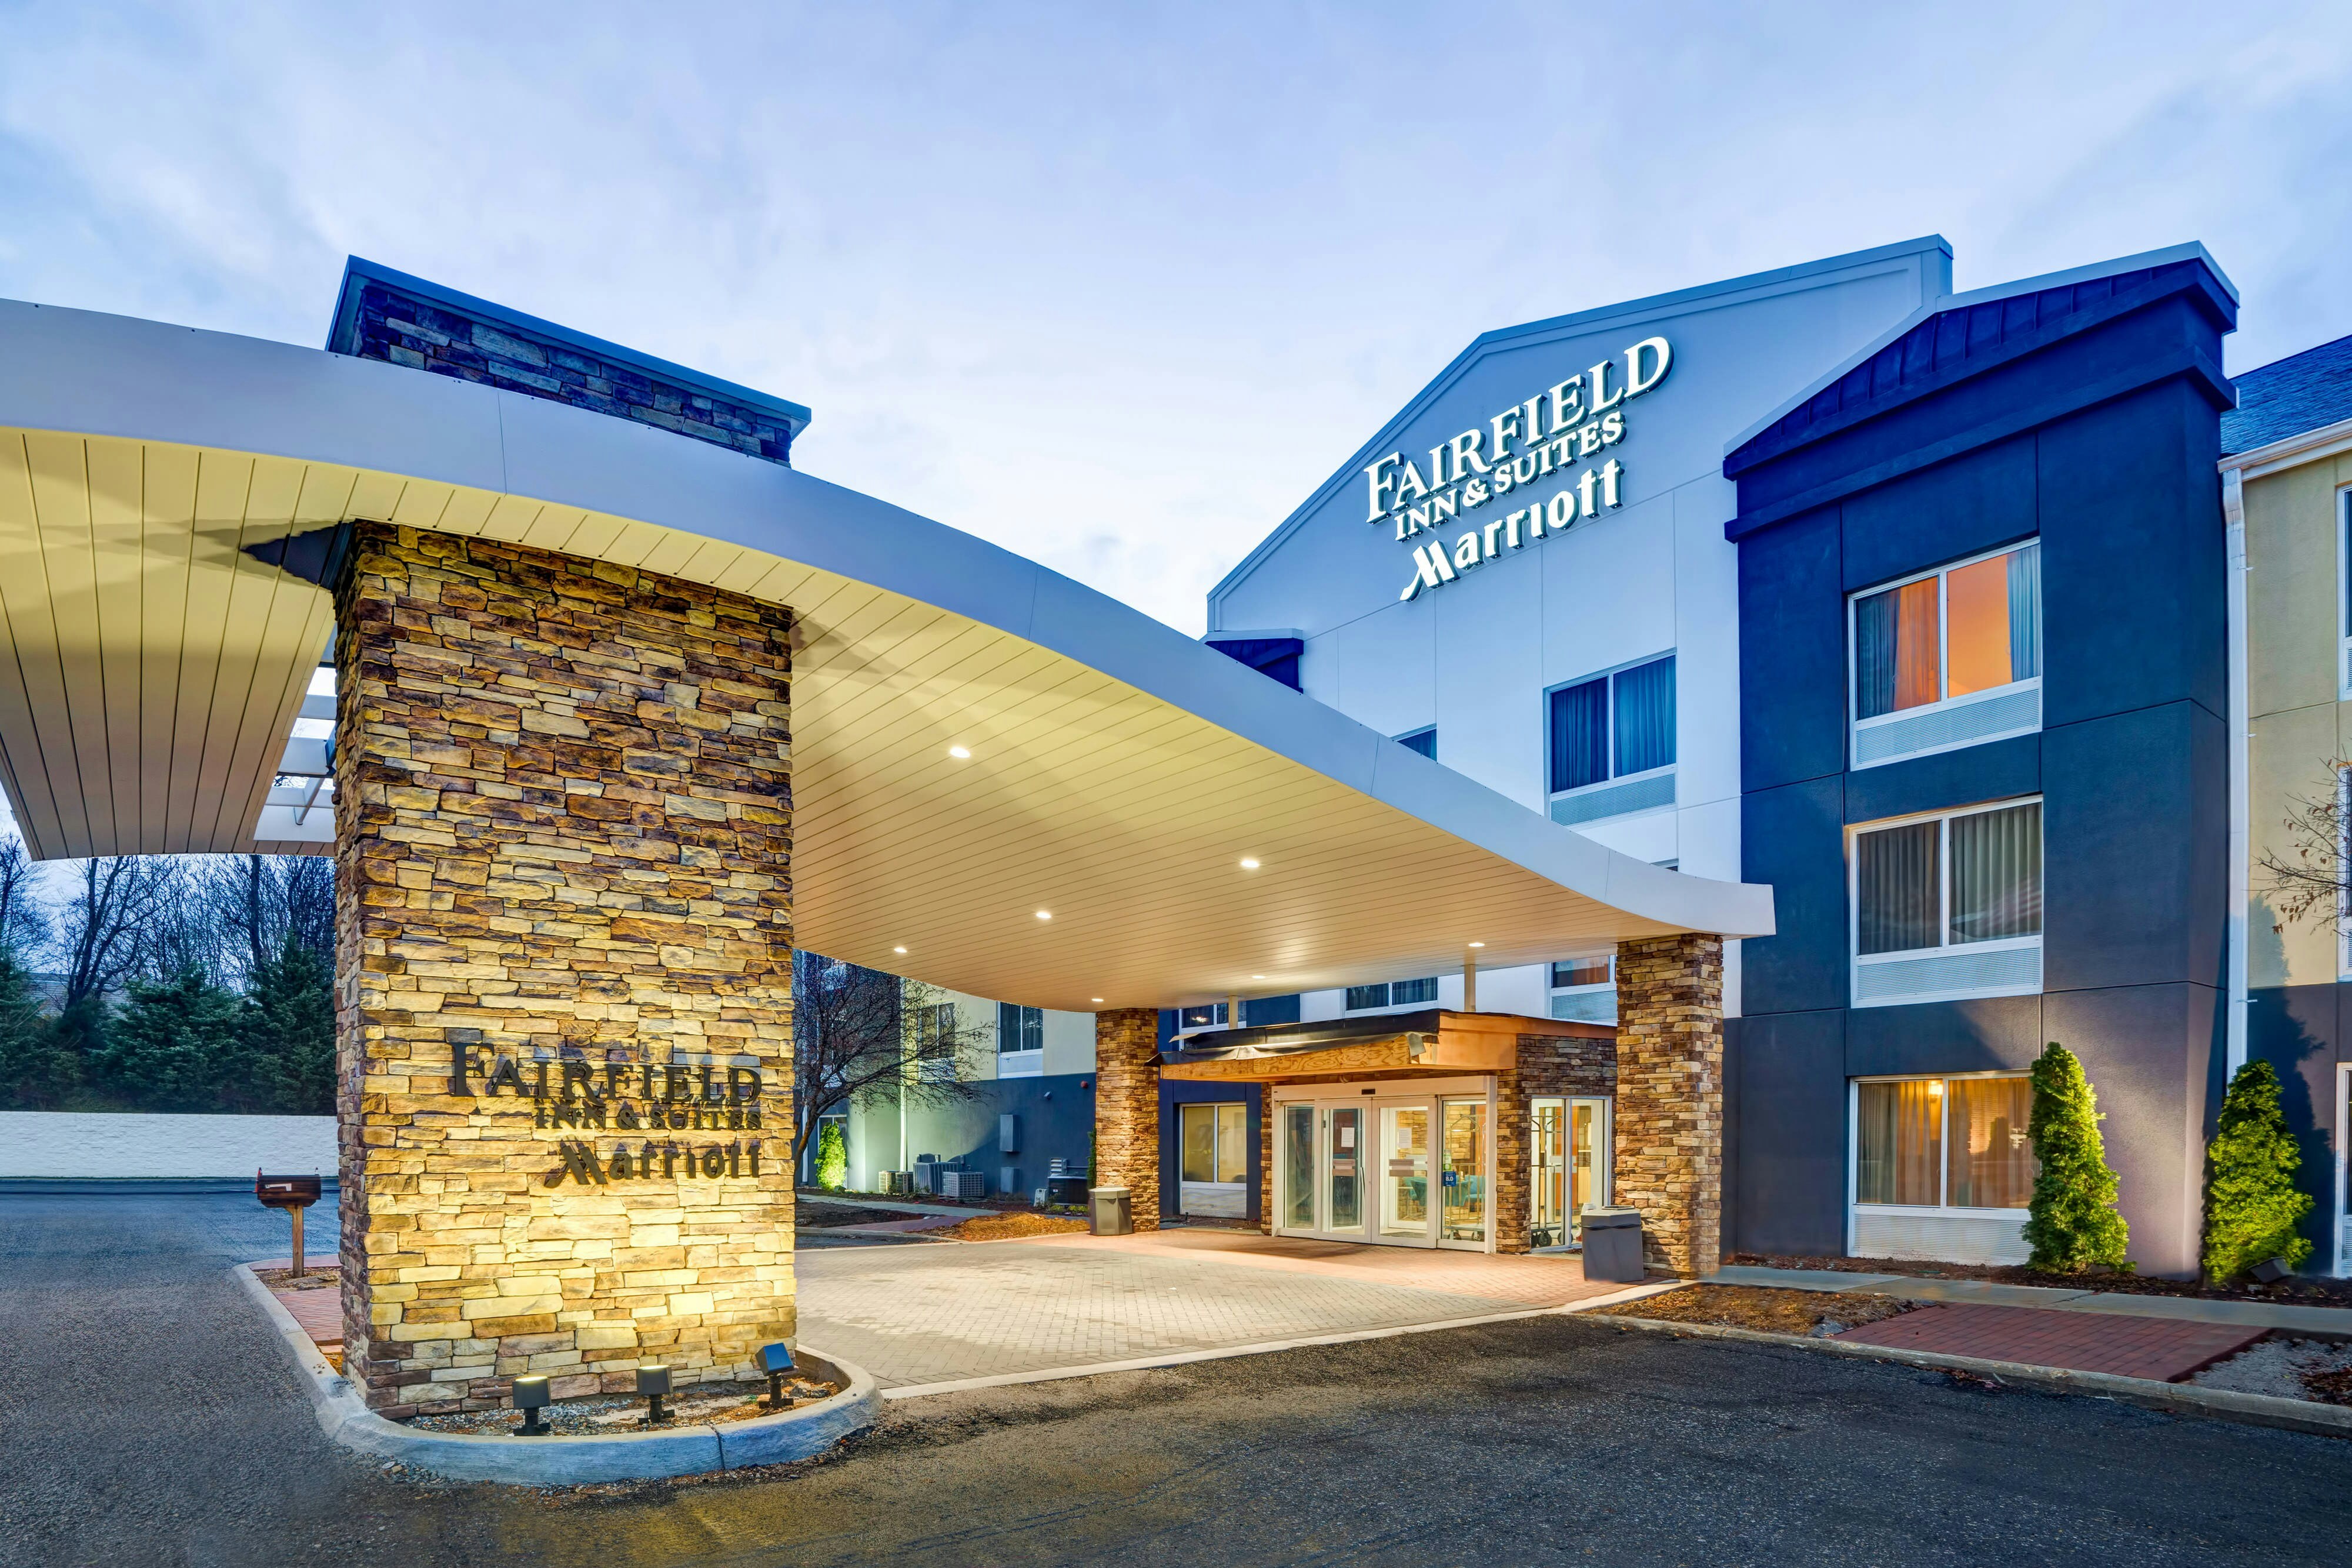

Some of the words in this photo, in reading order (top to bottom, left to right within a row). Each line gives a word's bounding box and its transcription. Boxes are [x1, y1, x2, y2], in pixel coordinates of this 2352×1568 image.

[1363, 336, 1674, 524] FAIRFIELD
[1394, 489, 1462, 541] INN
[1462, 478, 1494, 508] &
[1494, 412, 1627, 494] SUITES
[1399, 458, 1625, 602] Marriott
[449, 1041, 762, 1105] FAIRFIELD
[535, 1106, 608, 1129] INN
[616, 1108, 642, 1130] &
[650, 1109, 762, 1130] SUITES
[544, 1145, 761, 1188] Marriott
